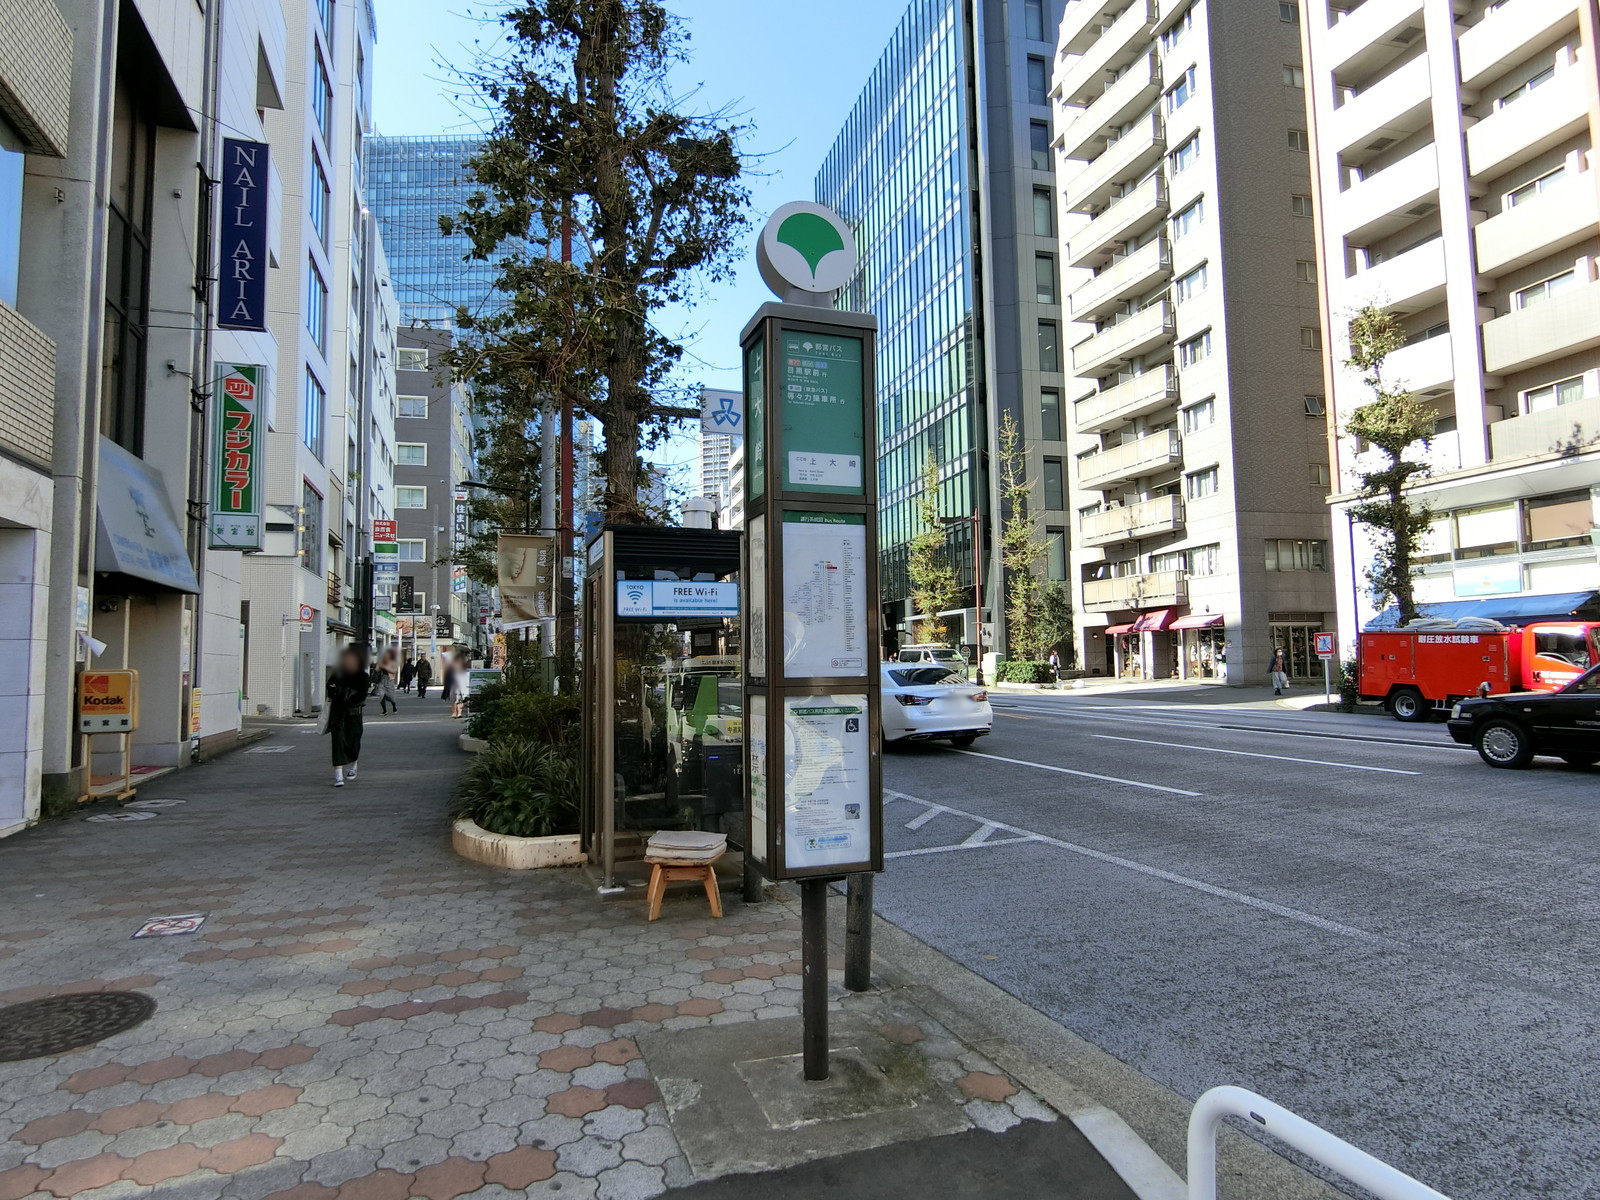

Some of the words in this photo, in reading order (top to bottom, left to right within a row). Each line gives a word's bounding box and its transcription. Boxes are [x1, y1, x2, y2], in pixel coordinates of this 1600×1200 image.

[233, 146, 258, 228] NAIL
[231, 239, 255, 321] ARIA
[225, 411, 253, 510] フジカラー
[537, 549, 547, 567] Asia
[673, 588, 692, 596] FREE
[695, 588, 718, 596] Wi-Fi
[1418, 635, 1479, 644] 耐圧放水試験車
[84, 695, 124, 706] Kodak
